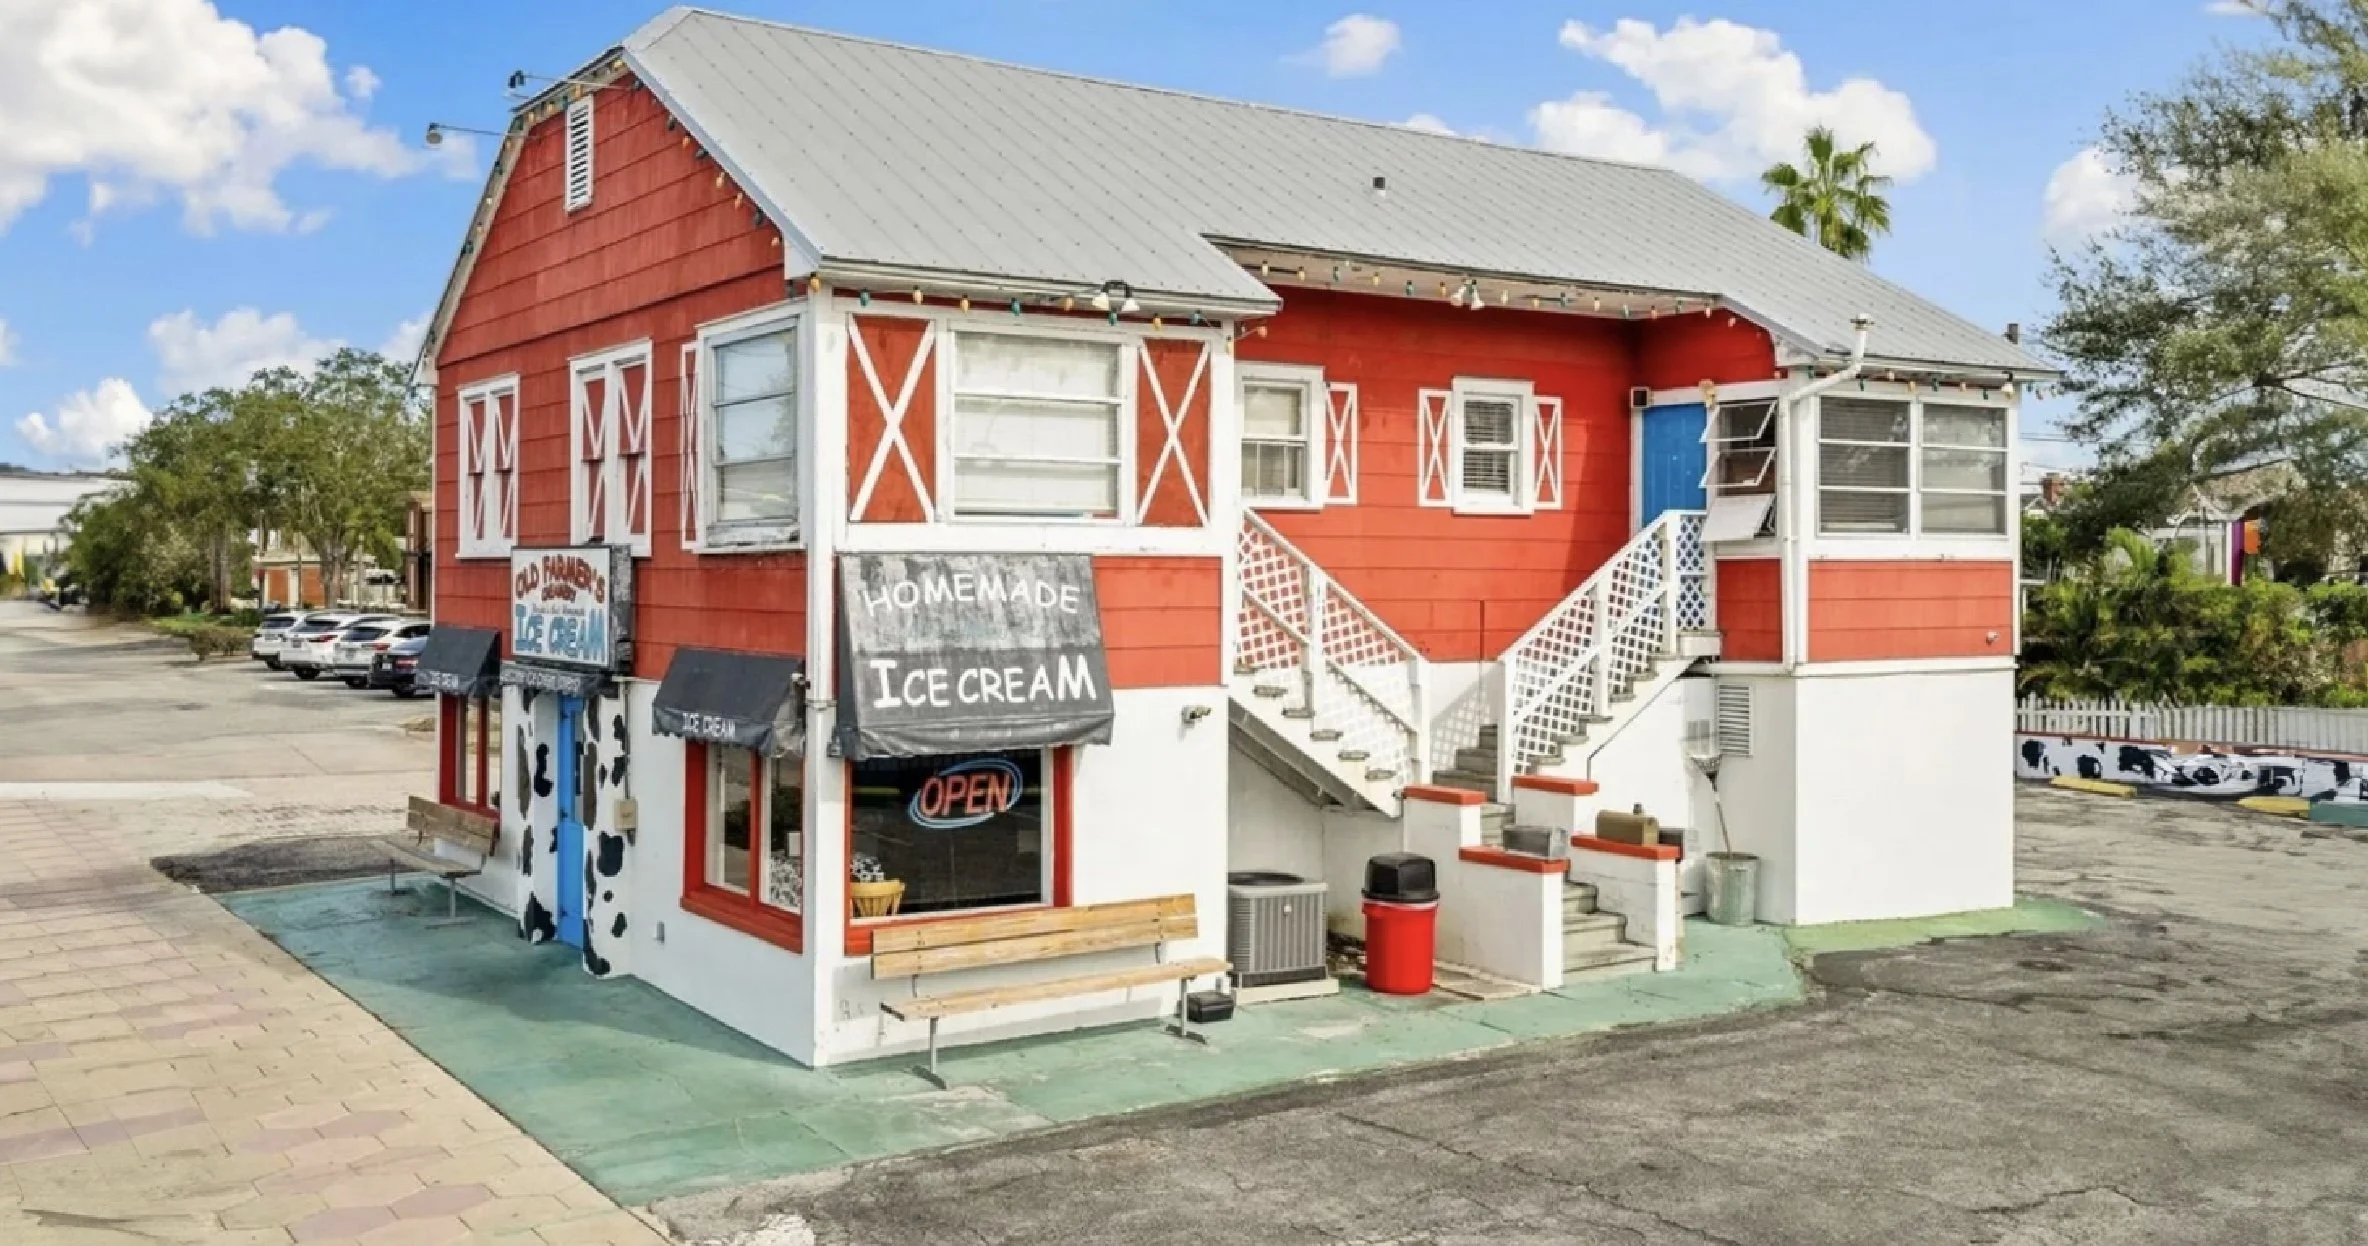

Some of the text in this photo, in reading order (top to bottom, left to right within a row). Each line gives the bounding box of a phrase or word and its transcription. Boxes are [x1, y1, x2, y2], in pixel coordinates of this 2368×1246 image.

[516, 562, 539, 598] OLD
[542, 553, 605, 604] FARMER'S
[861, 573, 1080, 617] HOMEMADE
[515, 604, 605, 661] ICE CREAM
[870, 654, 1097, 708] ICE CREAM
[682, 712, 736, 739] ICE CREAM
[920, 773, 1011, 817] OPEN
